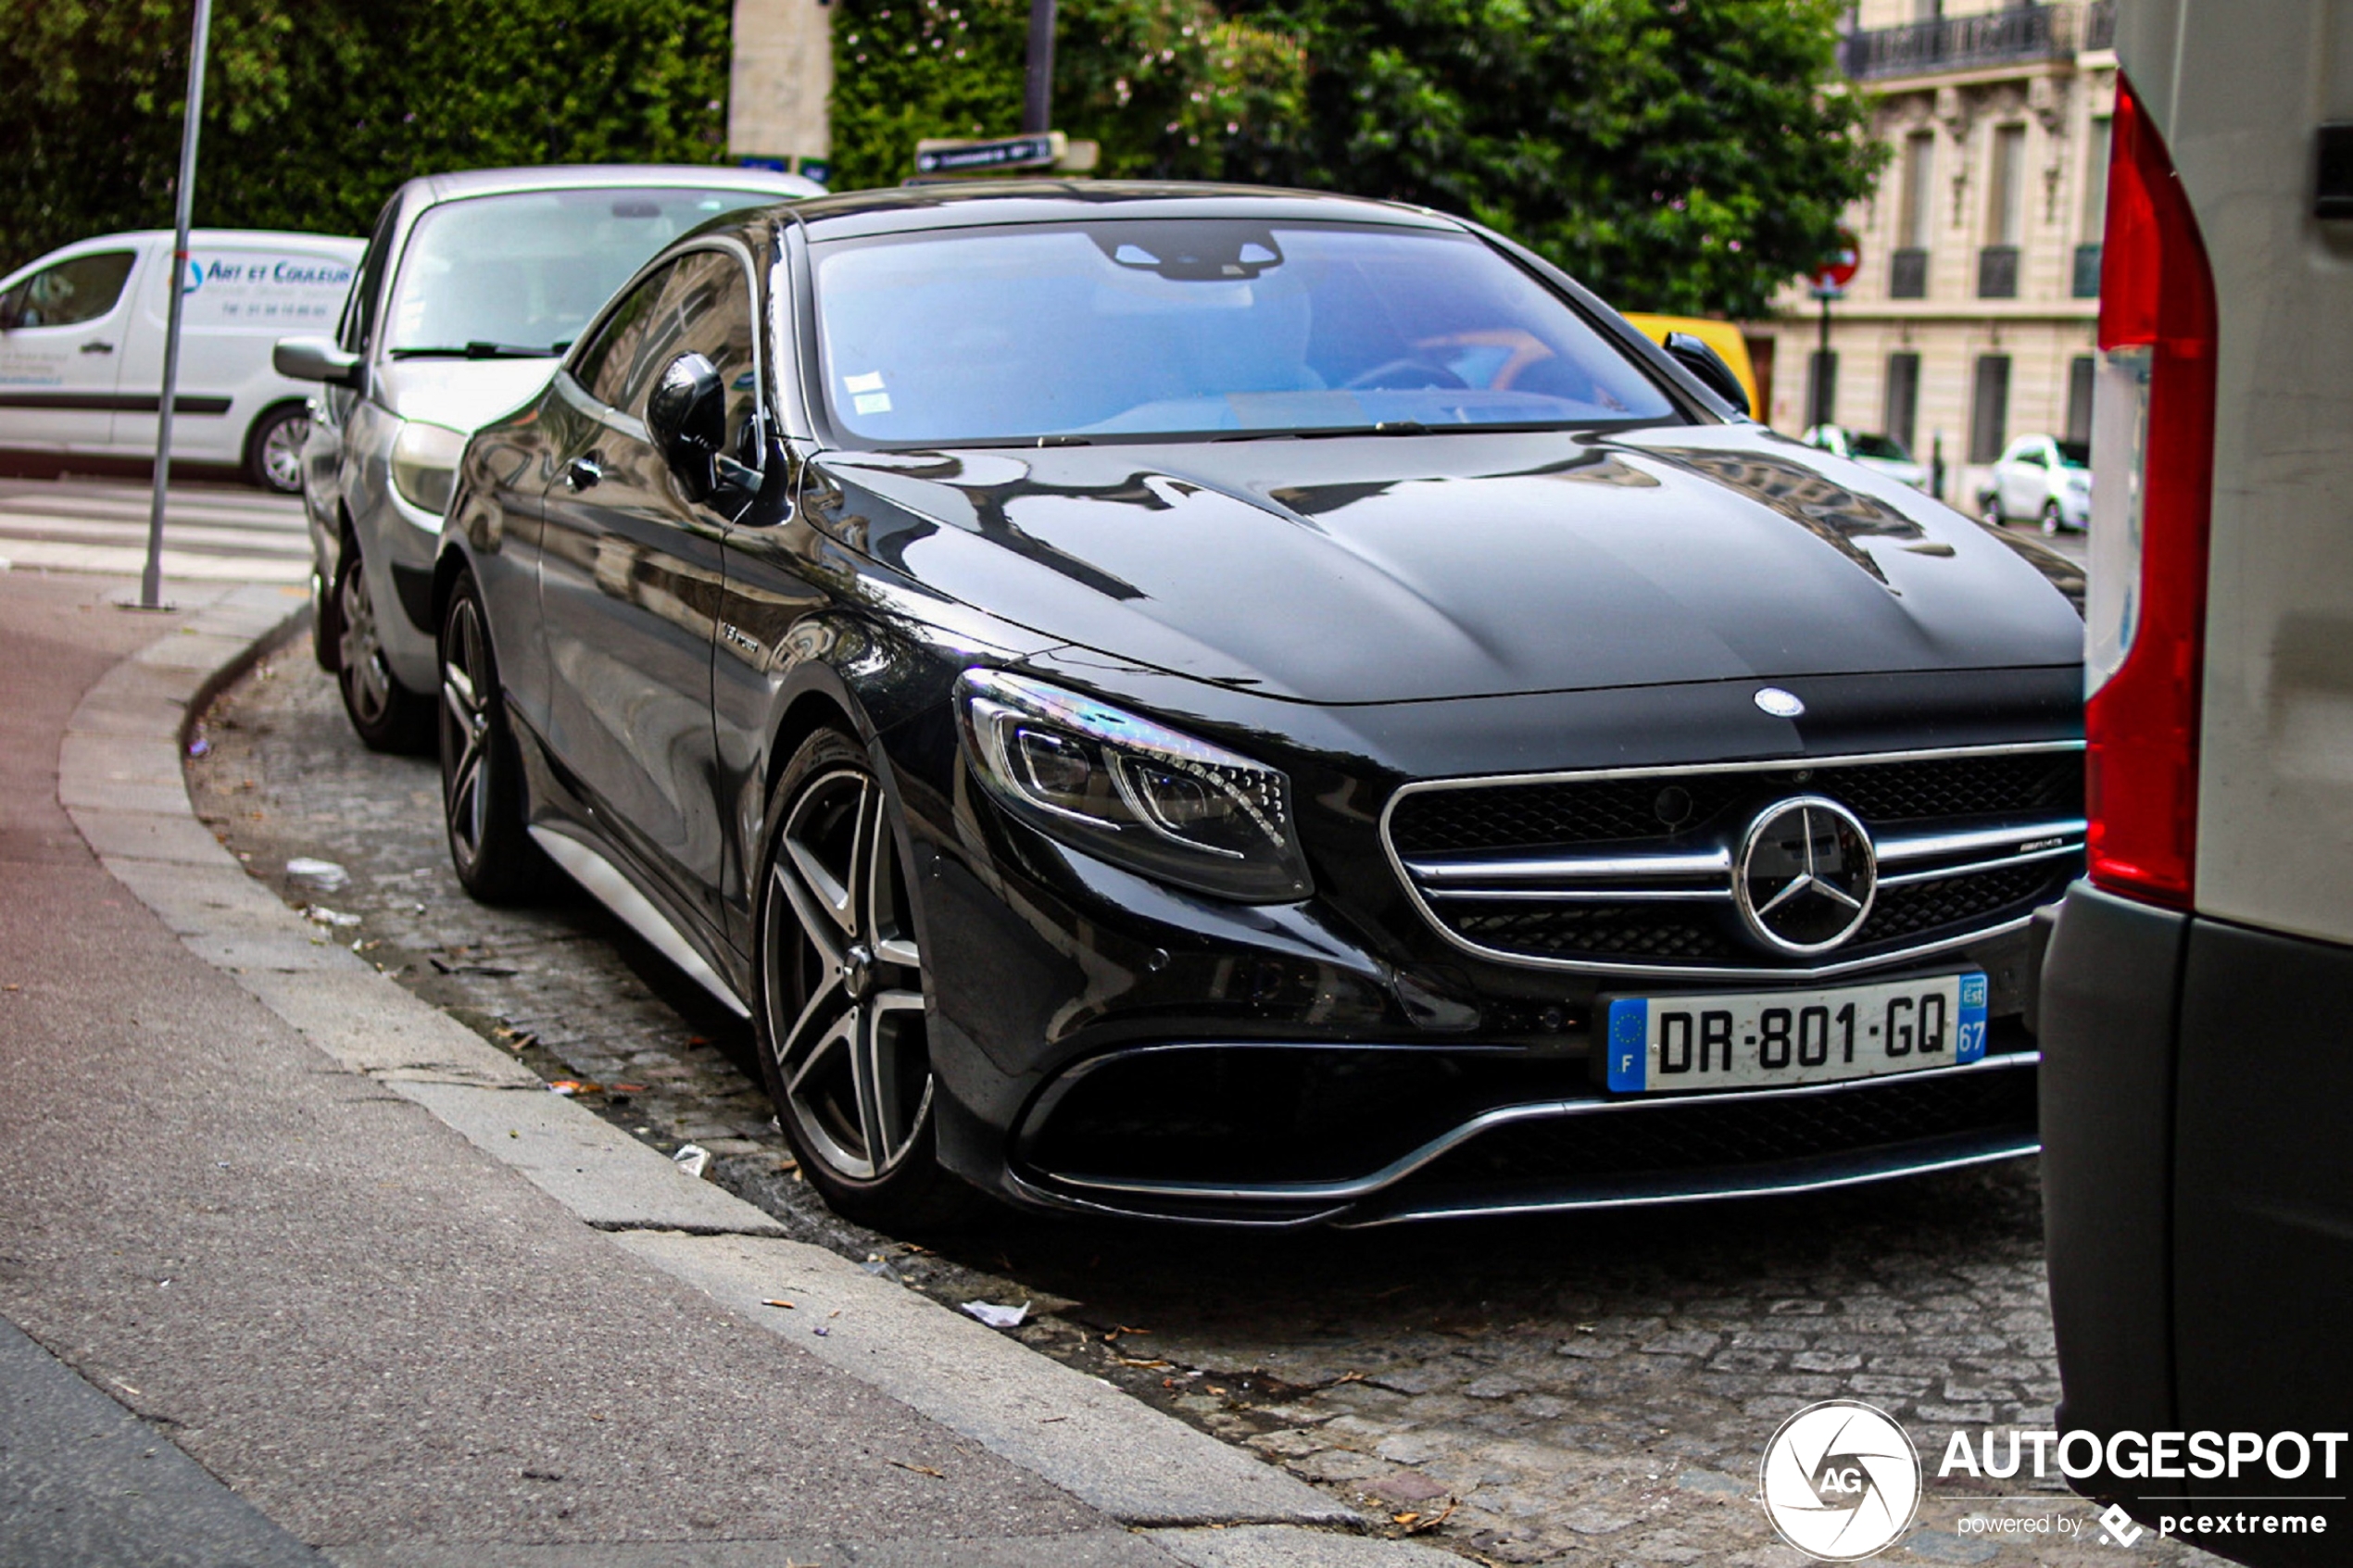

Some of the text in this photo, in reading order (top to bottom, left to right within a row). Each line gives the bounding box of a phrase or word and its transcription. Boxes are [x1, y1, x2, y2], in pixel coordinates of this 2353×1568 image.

[1659, 994, 1946, 1074] DR-801-GQ
[1959, 1020, 1986, 1052] 67
[1621, 1055, 1633, 1073] F
